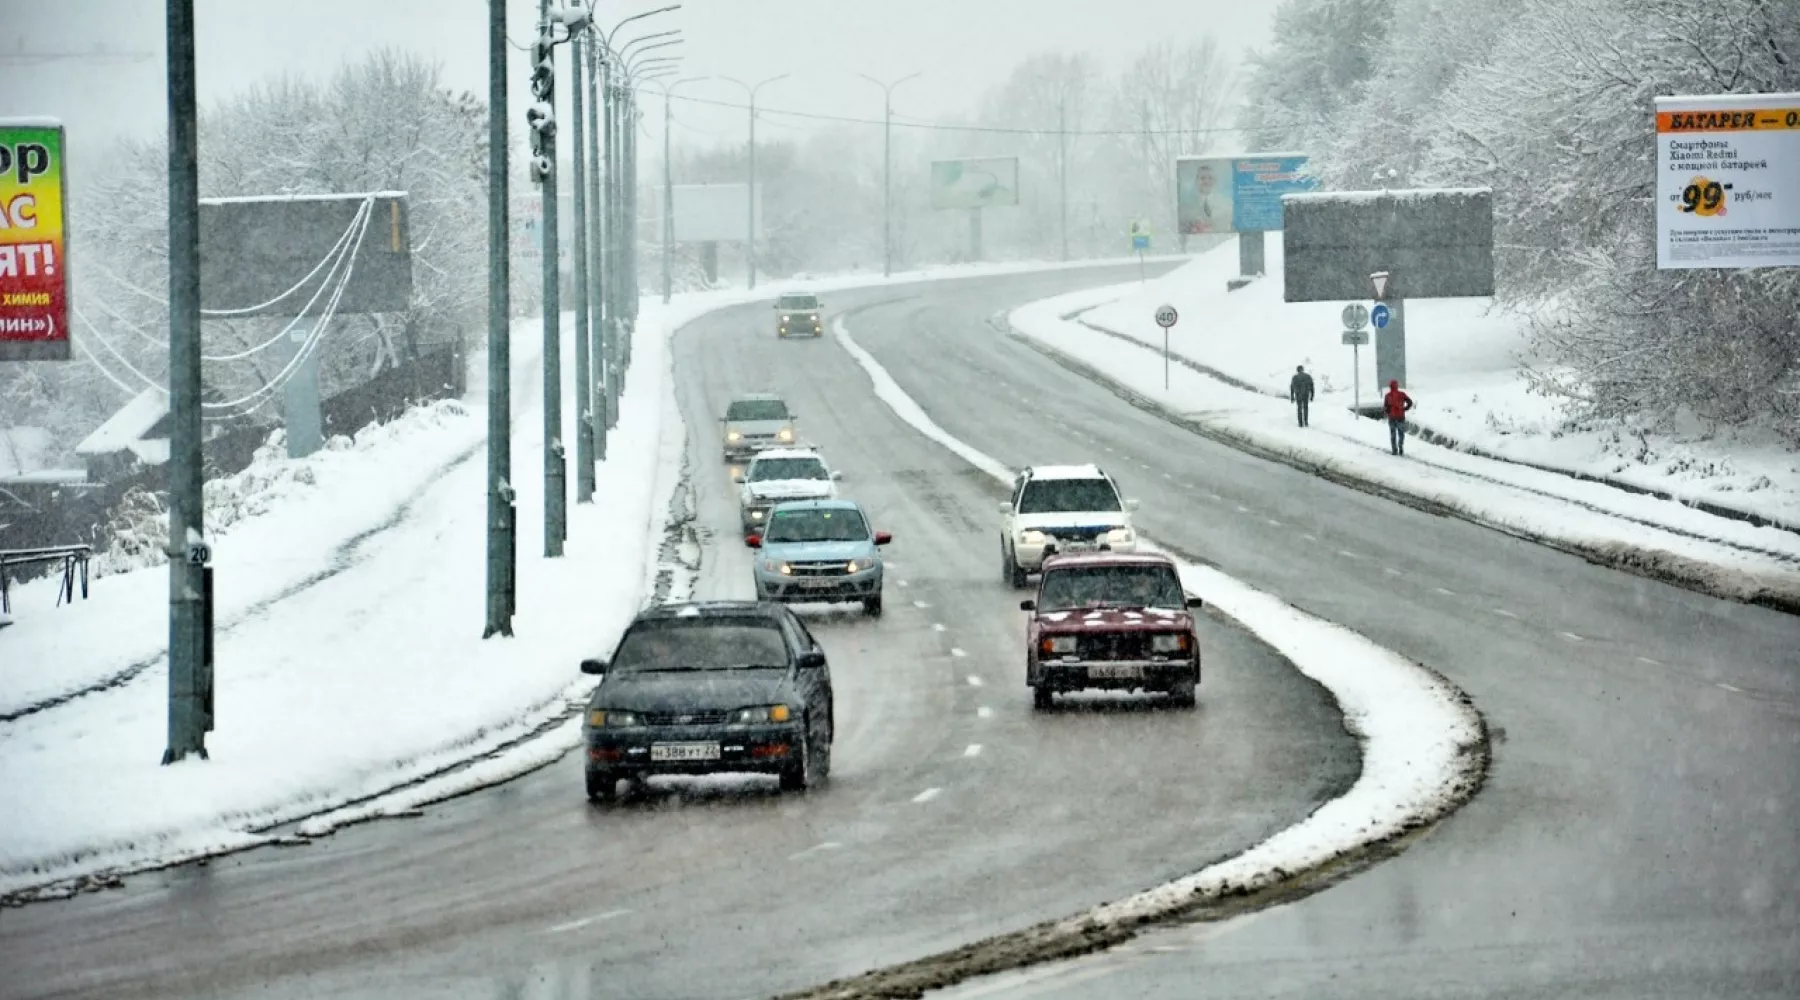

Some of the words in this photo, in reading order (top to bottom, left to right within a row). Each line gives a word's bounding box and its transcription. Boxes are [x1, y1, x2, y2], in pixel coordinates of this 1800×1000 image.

[1670, 112, 1755, 128] БАТАРЕЯ
[1669, 139, 1729, 151] Смартфоны
[1669, 150, 1704, 160] Xiaomi
[1706, 148, 1738, 159] Redmi
[1720, 159, 1768, 171] батареей
[1158, 312, 1174, 321] 40
[191, 547, 208, 562] 20
